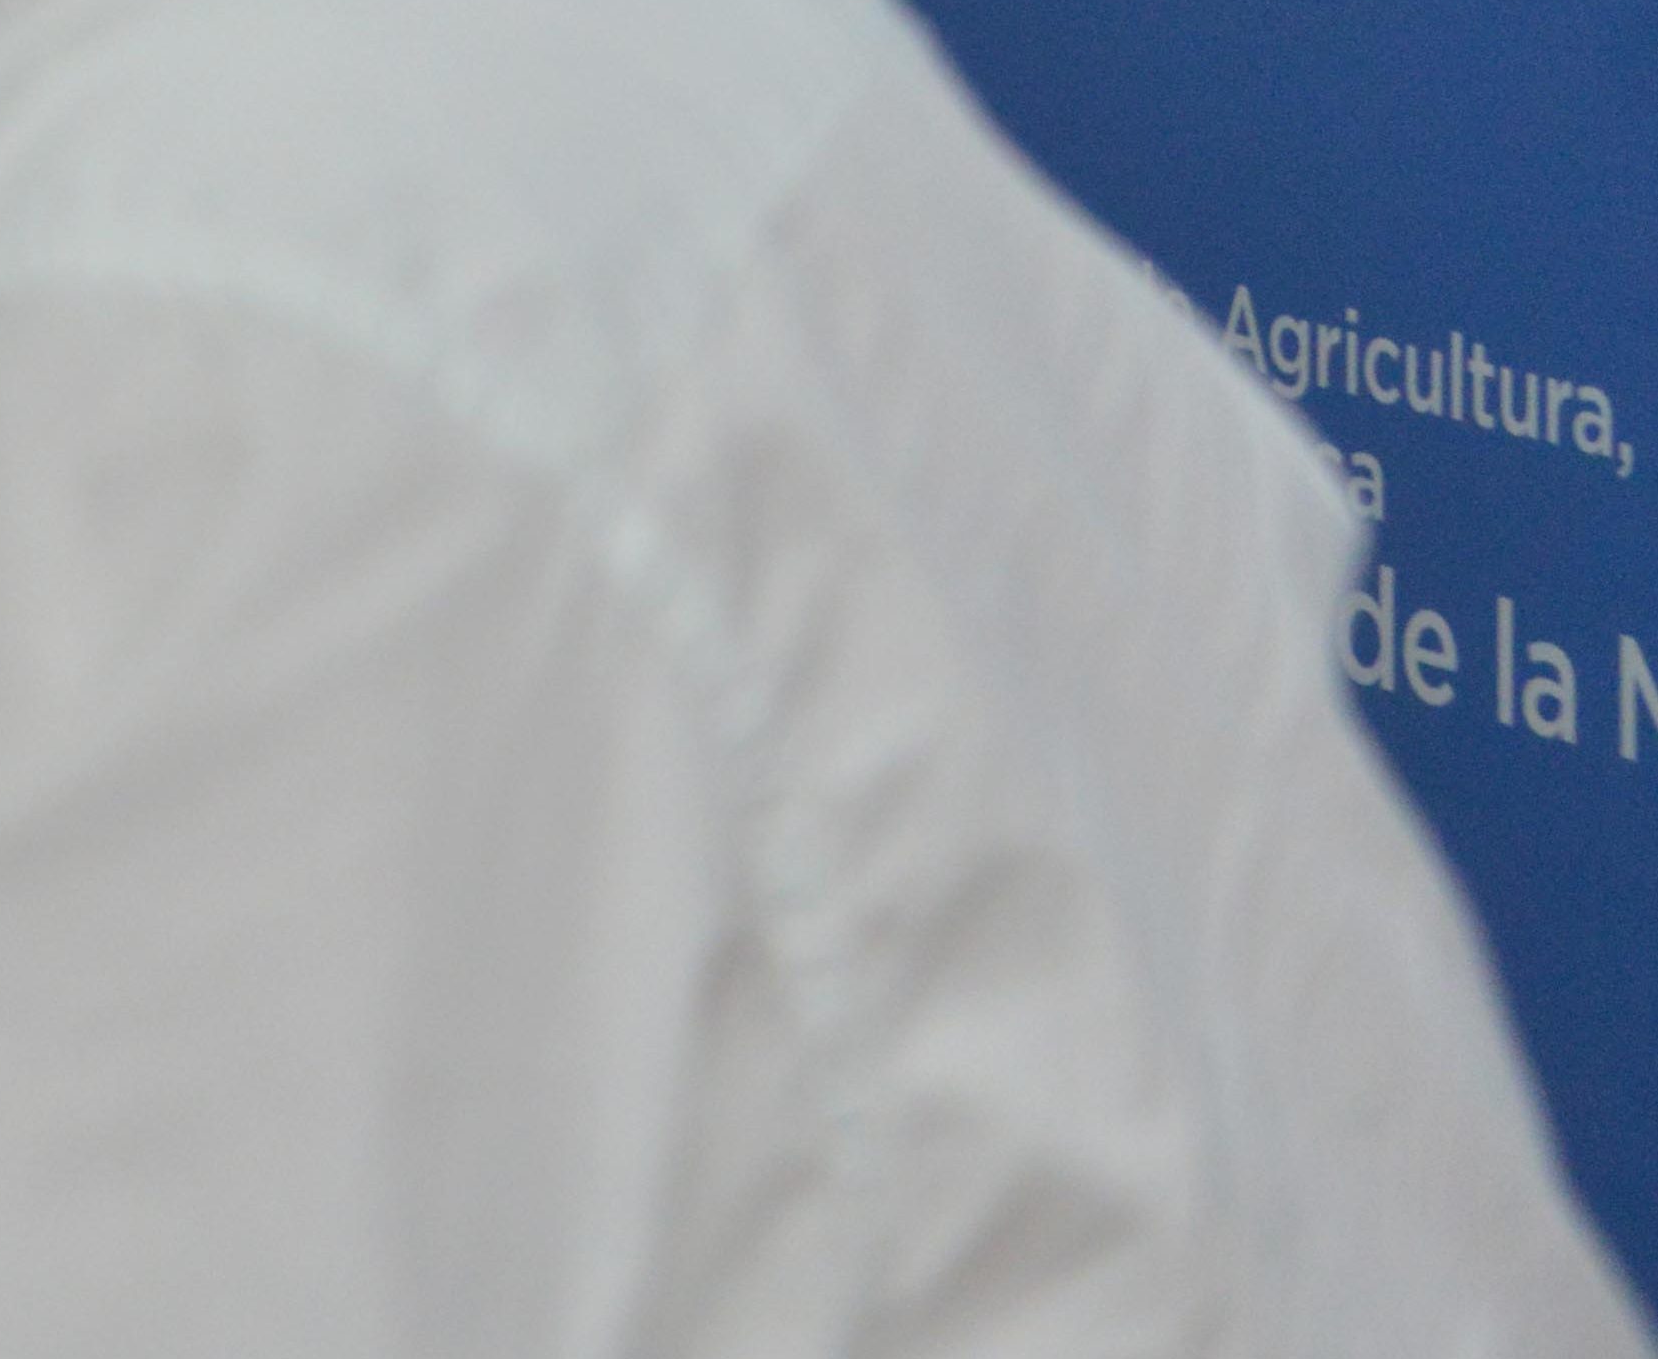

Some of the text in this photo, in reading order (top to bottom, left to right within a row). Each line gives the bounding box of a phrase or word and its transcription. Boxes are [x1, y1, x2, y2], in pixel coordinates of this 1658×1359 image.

[1225, 283, 1635, 479] Agricultura,
[1338, 563, 1459, 707] de
[1495, 595, 1579, 745] la
